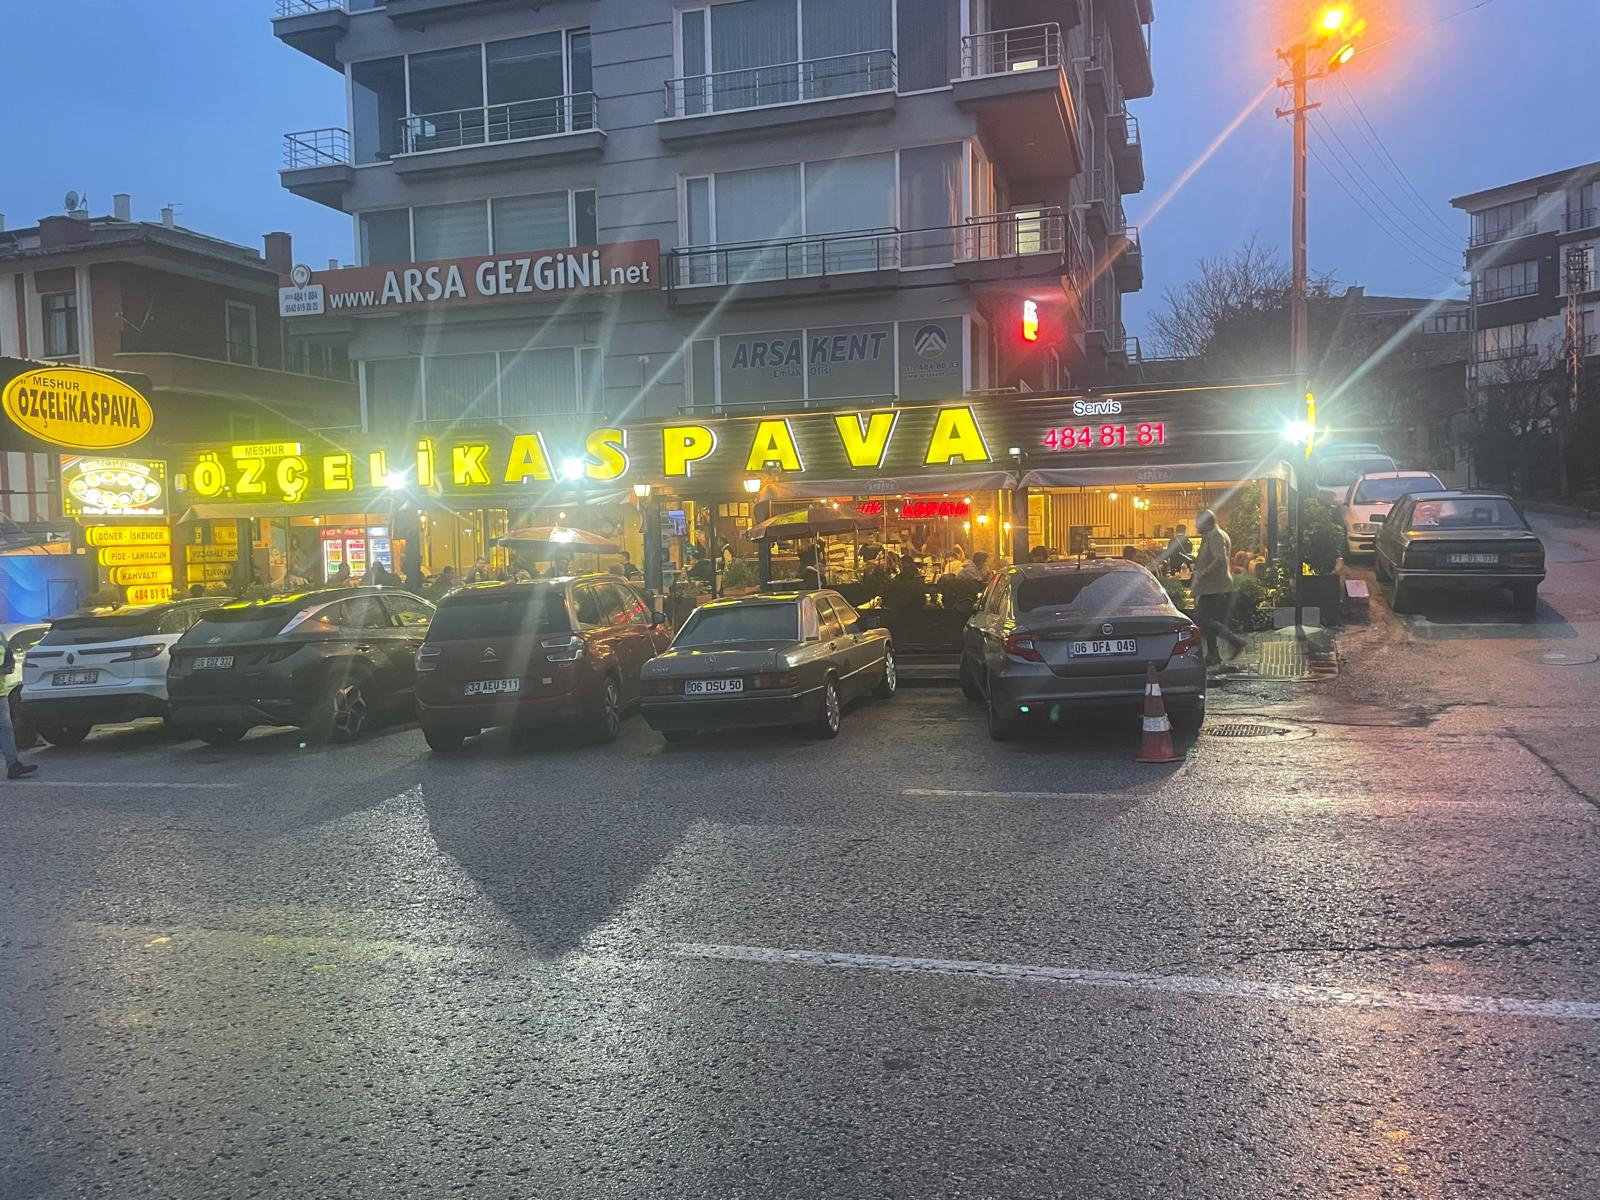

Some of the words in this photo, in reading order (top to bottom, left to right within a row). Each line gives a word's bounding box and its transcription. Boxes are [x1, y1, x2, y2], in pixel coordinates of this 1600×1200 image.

[731, 338, 800, 369] ARSA
[810, 332, 887, 364] KENT
[1073, 399, 1121, 416] Servis
[1043, 426, 1094, 450] 484
[1099, 423, 1126, 447] 81
[1137, 421, 1165, 446] 81
[131, 551, 167, 560] LAHMACUN
[121, 571, 158, 581] KAHVALTI
[134, 589, 148, 600] 484
[150, 589, 158, 599] 81
[1075, 642, 1087, 653] 06
[1093, 641, 1111, 653] DFA
[1117, 640, 1135, 651] 049
[469, 682, 480, 691] 33
[483, 680, 500, 690] AEU
[501, 680, 518, 689] 911
[691, 682, 702, 692] 06
[706, 681, 727, 691] DSU
[729, 680, 741, 690] 50
